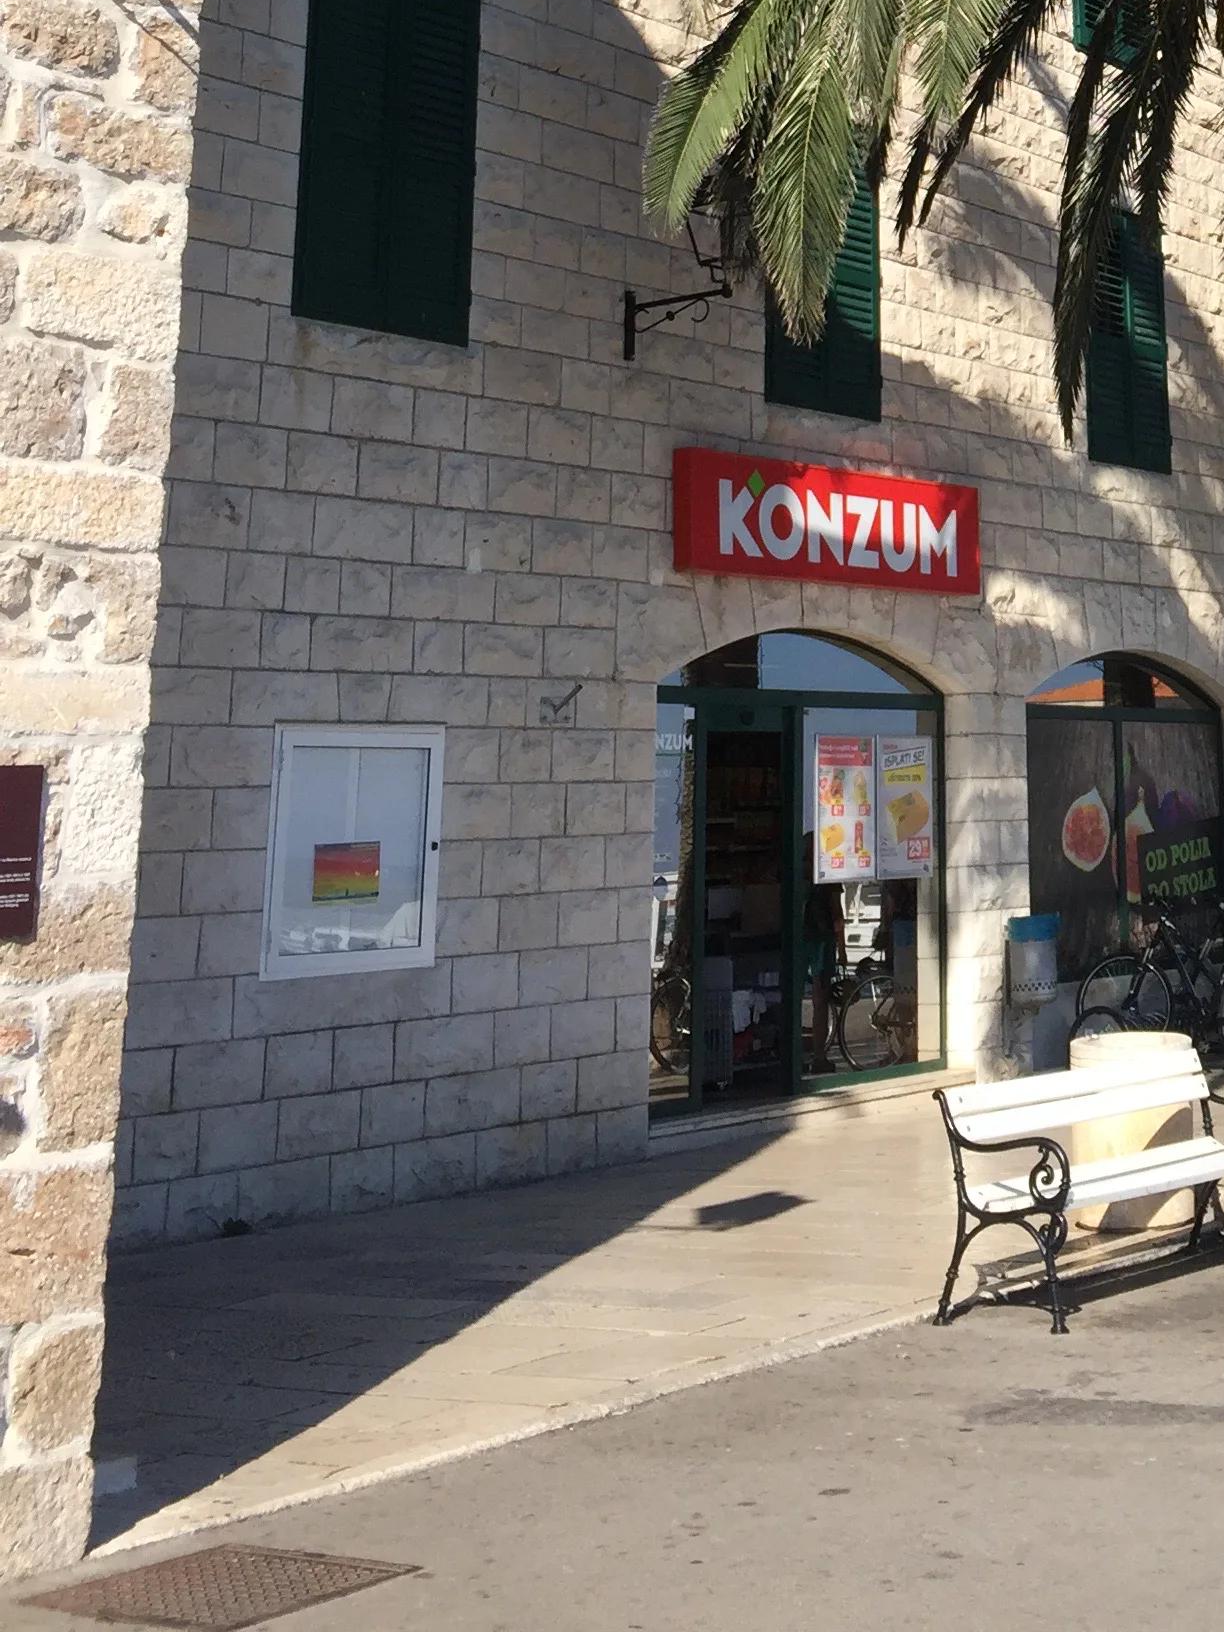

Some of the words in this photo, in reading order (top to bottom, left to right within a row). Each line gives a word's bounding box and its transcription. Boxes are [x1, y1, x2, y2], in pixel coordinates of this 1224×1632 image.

[718, 478, 958, 577] KONZUM
[655, 733, 693, 751] NZUM
[1146, 849, 1168, 872] OD
[1172, 867, 1217, 897] STOLA
